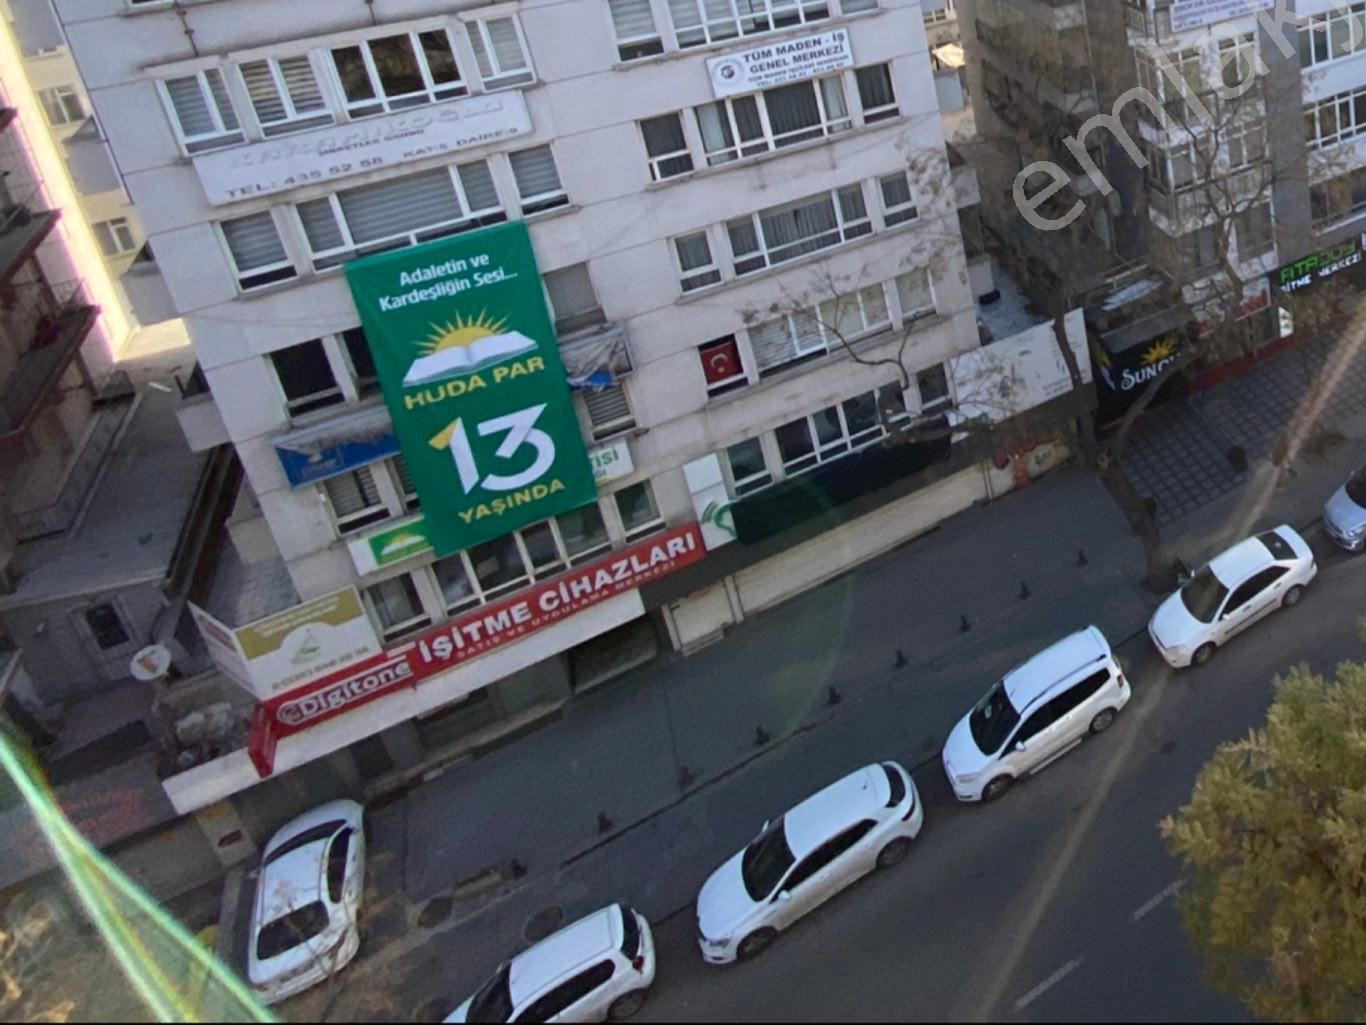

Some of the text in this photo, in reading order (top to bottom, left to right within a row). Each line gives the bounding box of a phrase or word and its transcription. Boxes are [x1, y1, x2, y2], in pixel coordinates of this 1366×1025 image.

[743, 49, 773, 63] TÜM
[776, 37, 822, 56] MADEN
[750, 60, 789, 74] GENEL
[792, 44, 844, 63] MERKEZİ
[400, 253, 490, 287] Adaletin ve
[379, 277, 471, 312] Kardeşliğin
[404, 356, 545, 409] HUDA PAR
[428, 402, 556, 495] 13
[458, 479, 566, 524] YAŞINDA
[418, 600, 535, 663] İŞİTME
[539, 532, 695, 610] CİHAZLARI
